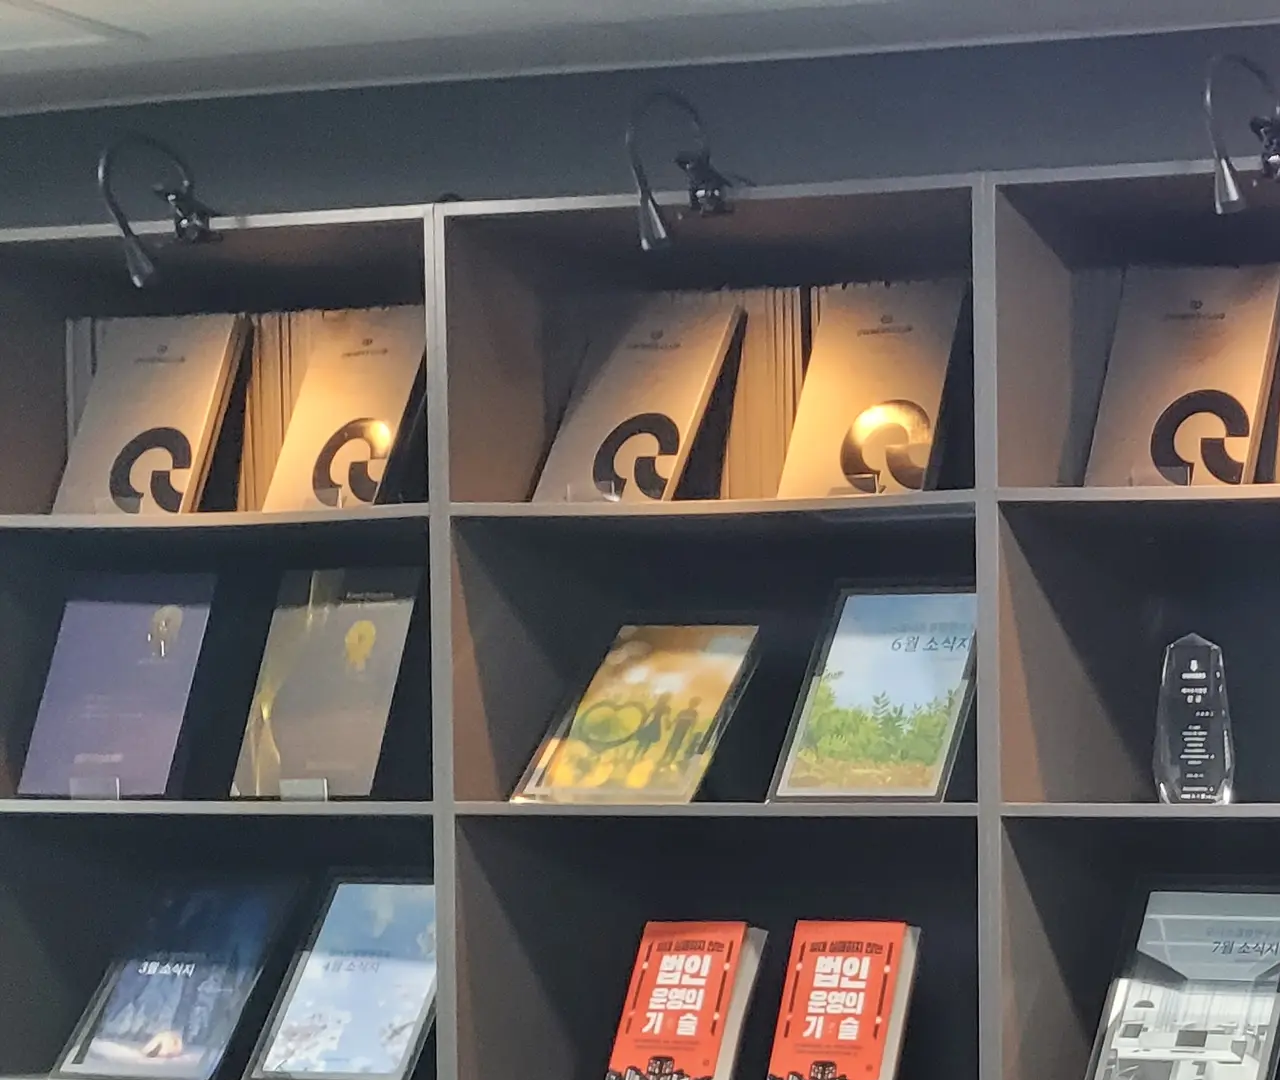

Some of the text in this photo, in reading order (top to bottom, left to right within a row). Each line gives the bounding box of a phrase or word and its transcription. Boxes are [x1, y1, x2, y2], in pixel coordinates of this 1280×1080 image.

[890, 635, 920, 652] 6월
[1237, 941, 1280, 957] 소식지
[656, 954, 712, 986] 법인
[812, 955, 871, 989] 법인
[648, 987, 705, 1012] 운영의
[807, 990, 865, 1015] 운영의
